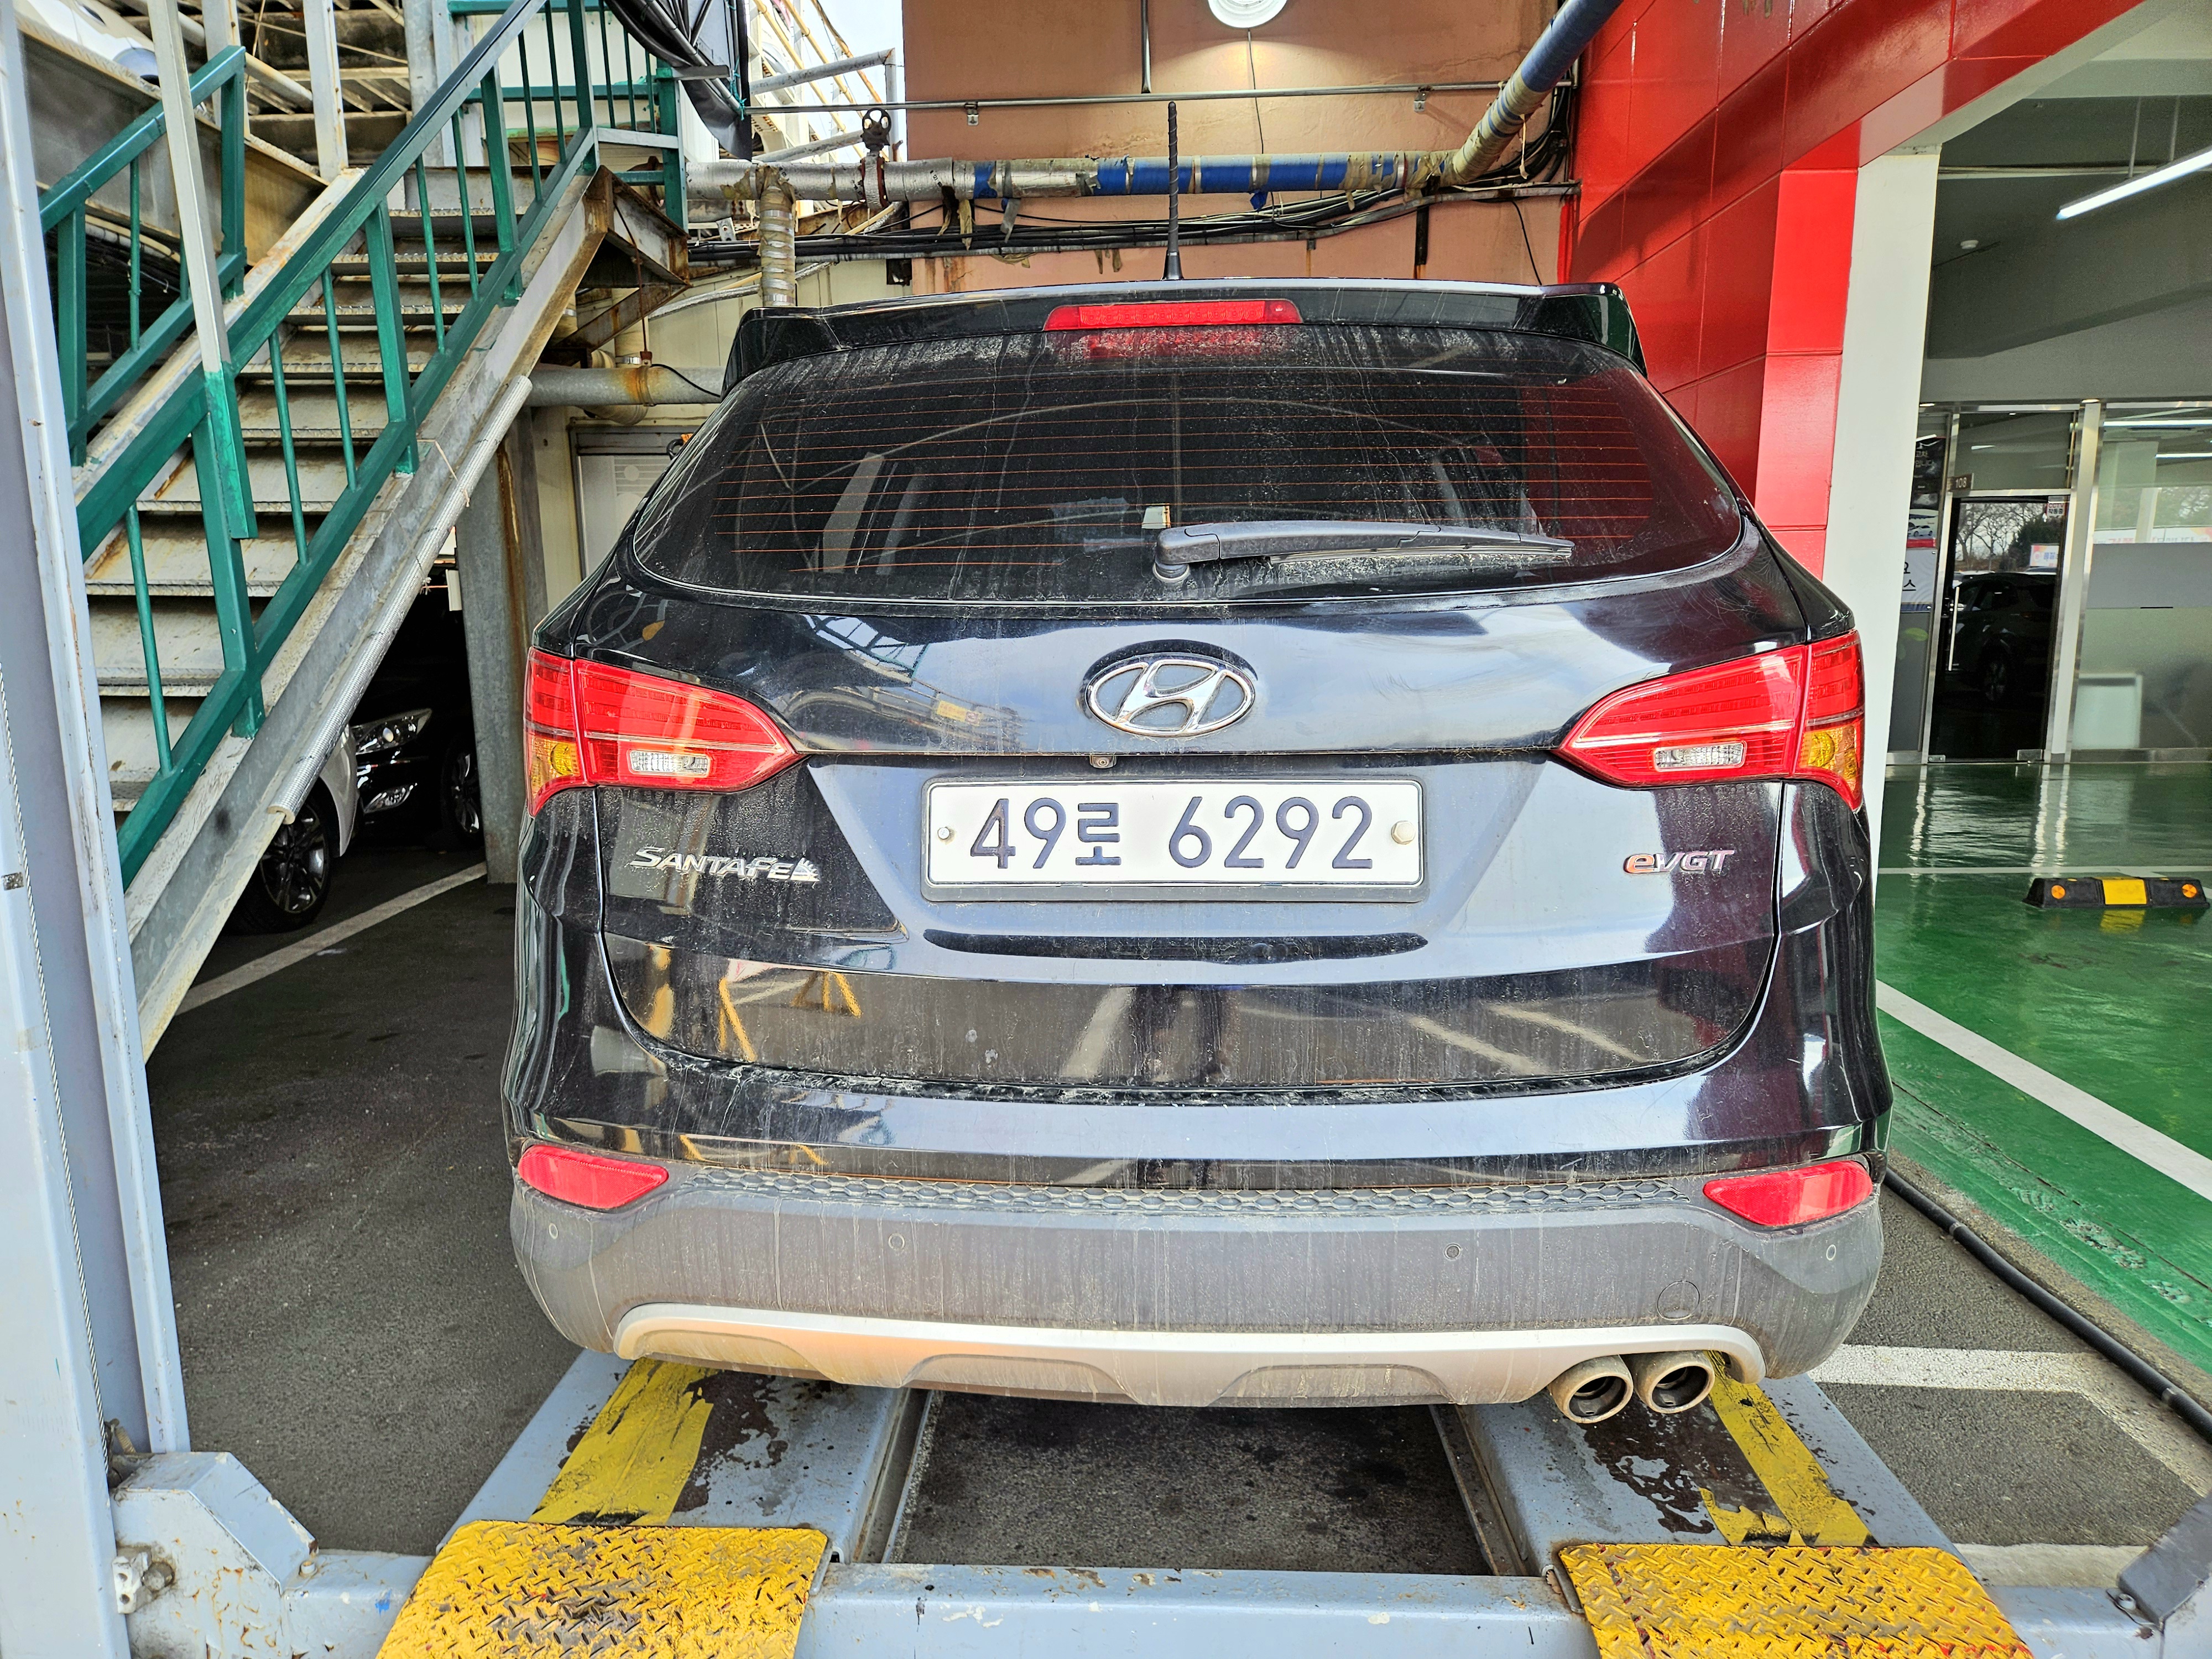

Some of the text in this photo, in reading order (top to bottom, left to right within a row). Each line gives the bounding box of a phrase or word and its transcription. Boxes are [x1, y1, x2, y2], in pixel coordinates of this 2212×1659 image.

[1955, 477, 1967, 488] 108
[970, 795, 1373, 869] 49로 6292
